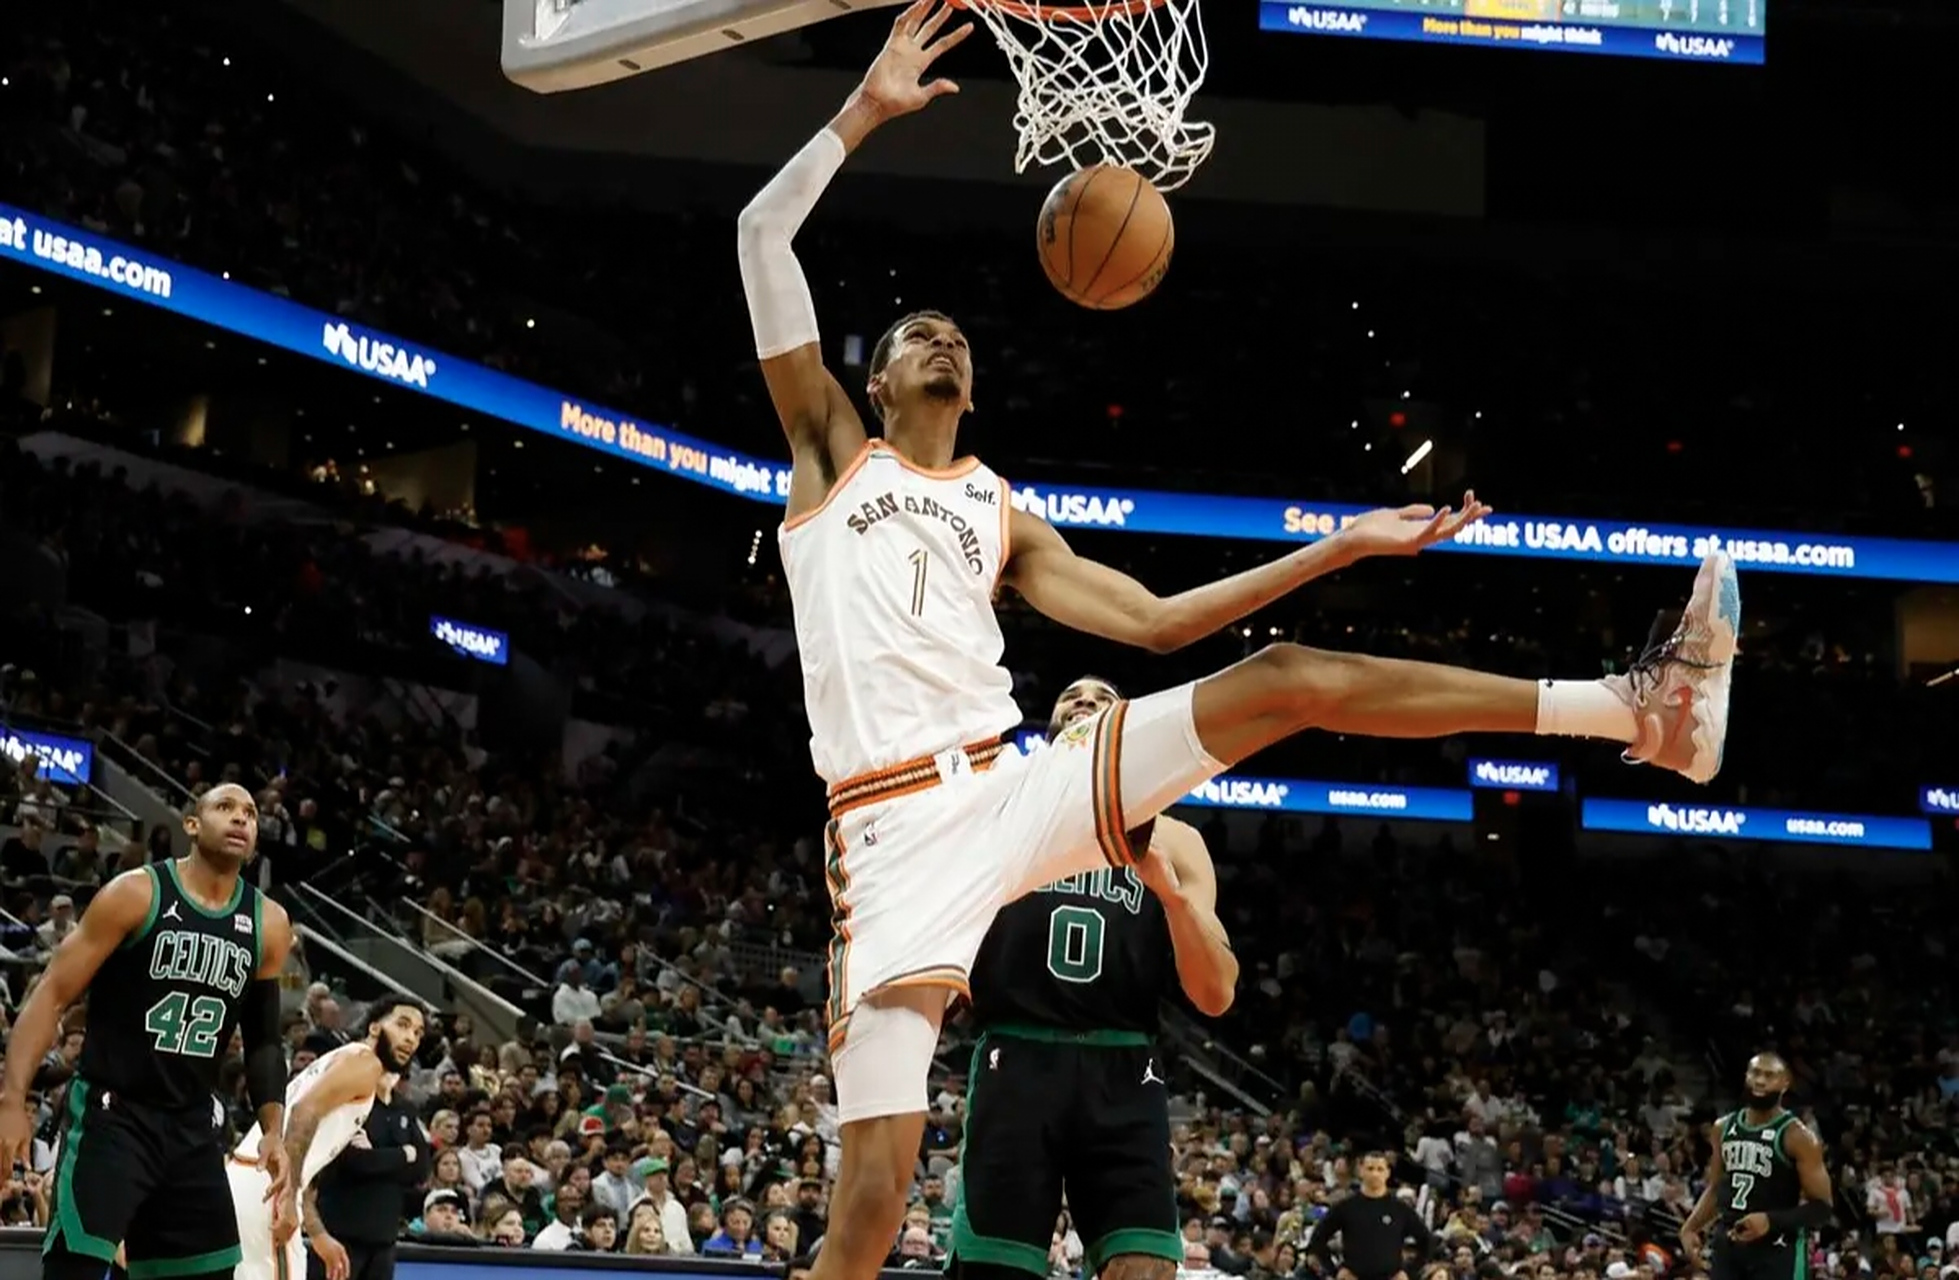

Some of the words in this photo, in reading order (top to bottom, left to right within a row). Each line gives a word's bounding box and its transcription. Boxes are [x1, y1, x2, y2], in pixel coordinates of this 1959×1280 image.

[1313, 11, 1362, 32] USAA
[1680, 36, 1729, 57] USAA
[33, 229, 171, 298] usaa.com
[358, 336, 428, 388] USAA
[561, 402, 616, 443] More
[618, 422, 666, 461] than
[669, 443, 708, 474] you
[710, 455, 771, 493] might
[847, 492, 899, 535] SAN
[905, 496, 984, 576] ANTONIO
[1047, 494, 1124, 526] USAA
[1284, 506, 1335, 535] See
[1454, 517, 1520, 547] what
[1524, 522, 1603, 552] USAA
[1607, 527, 1688, 558] offers
[1723, 538, 1854, 568] usaa.com
[908, 549, 928, 617] 1
[1221, 782, 1283, 806] USAA
[1500, 765, 1545, 785] USAA
[1677, 808, 1741, 834] USAA
[1786, 818, 1864, 838] usaa.com
[150, 930, 250, 999] CELTICS
[1047, 904, 1105, 983] 0
[145, 990, 227, 1058] 42
[1731, 1172, 1754, 1211] 7
